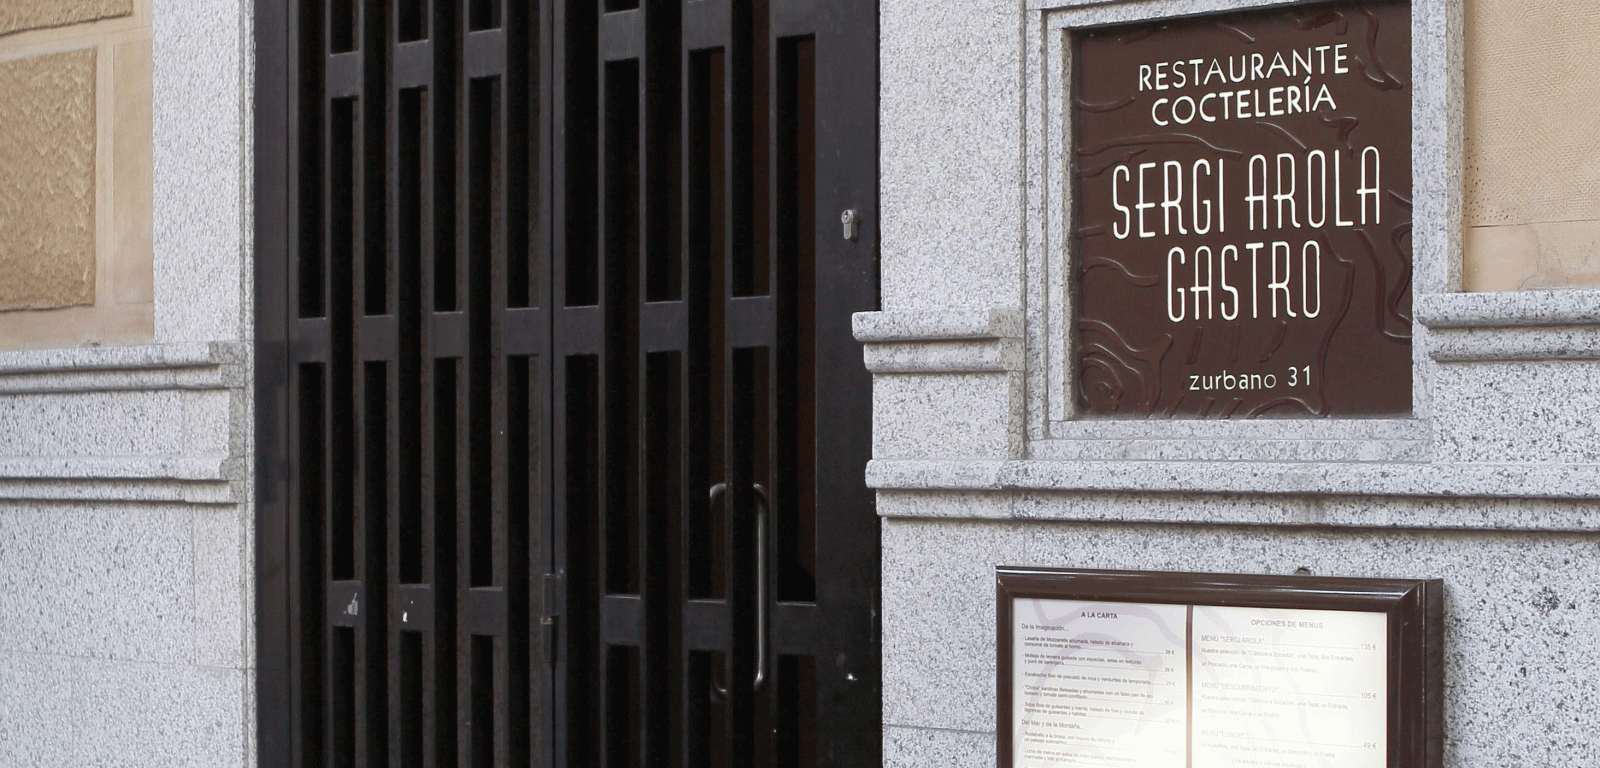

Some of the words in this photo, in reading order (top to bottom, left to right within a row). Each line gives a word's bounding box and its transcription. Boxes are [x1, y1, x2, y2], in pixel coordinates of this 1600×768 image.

[1139, 44, 1348, 92] RESTAURANTE
[1151, 76, 1336, 127] COCTELERÍA
[1112, 158, 1225, 240] SERGI
[1245, 146, 1381, 230] AROLA
[1167, 240, 1321, 322] GASTRO
[1189, 370, 1276, 391] zurbano
[1288, 365, 1311, 386] 31
[1250, 619, 1285, 627] OPCIONES
